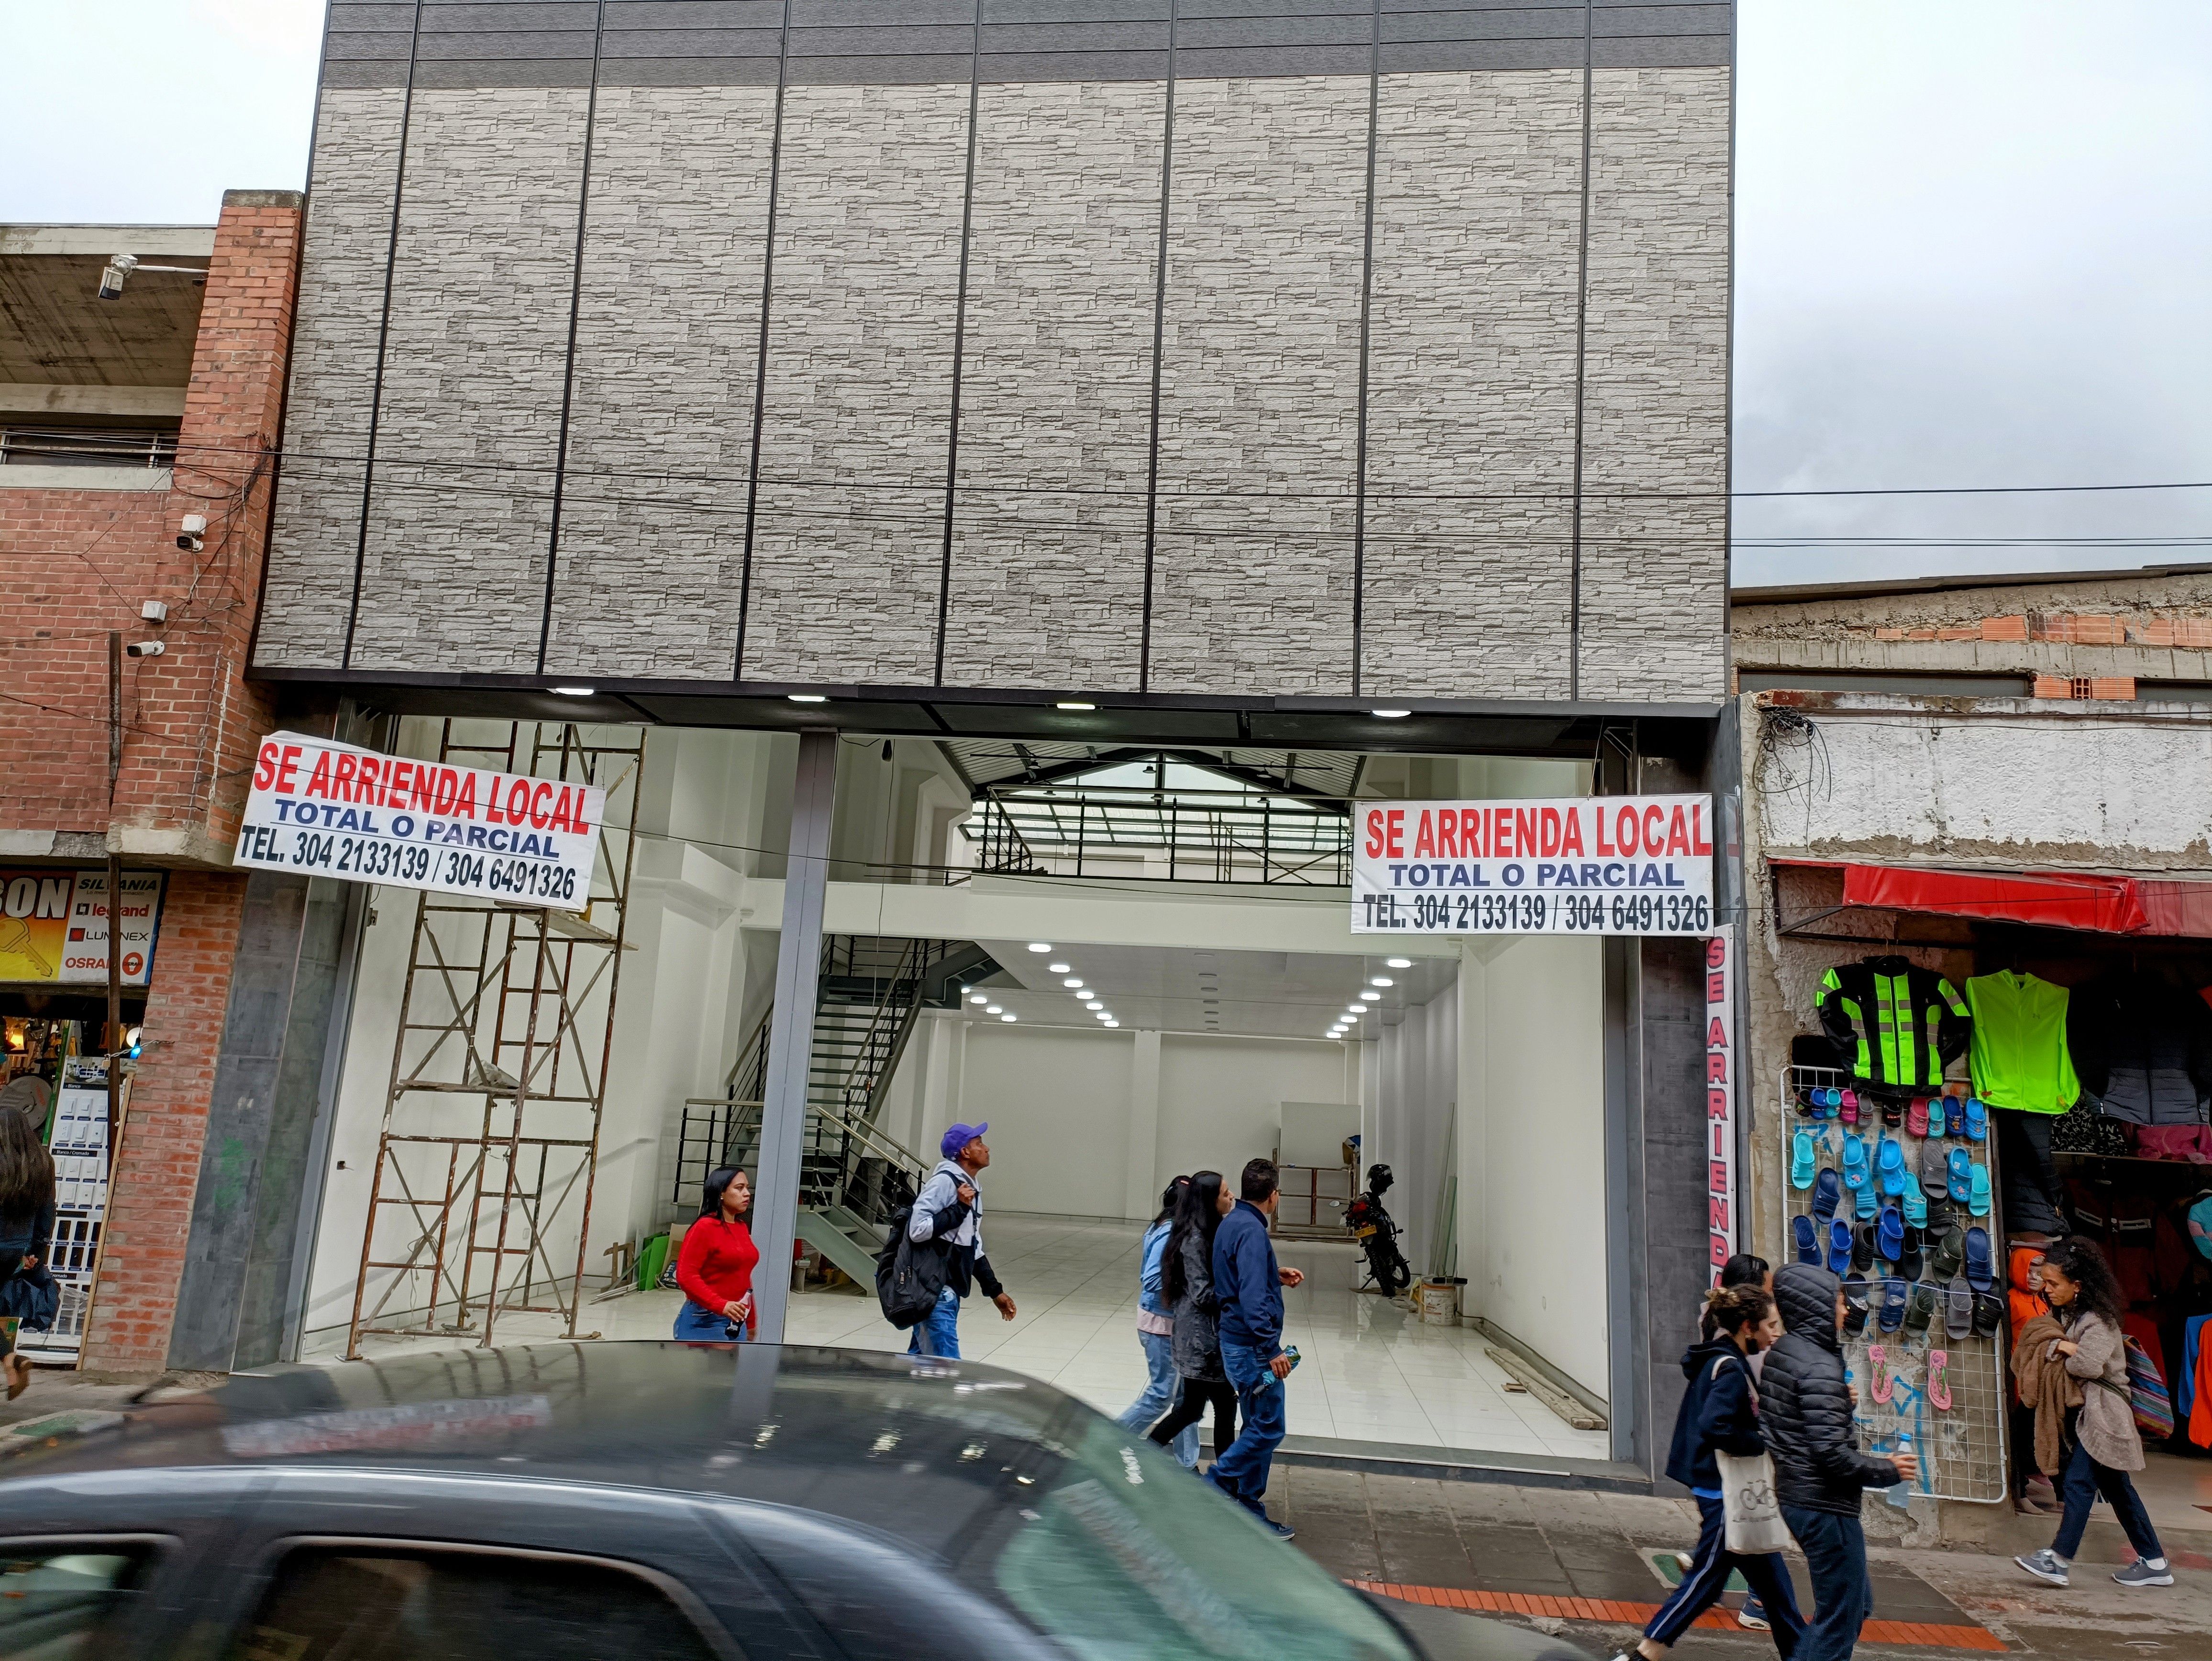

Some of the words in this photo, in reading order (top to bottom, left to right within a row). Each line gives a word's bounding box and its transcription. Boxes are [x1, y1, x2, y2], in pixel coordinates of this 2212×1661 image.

[254, 742, 303, 794] SE
[306, 751, 476, 819] ARRIENDA
[486, 776, 589, 835] LOCAL
[275, 799, 379, 833] TOTAL
[391, 816, 414, 837] O
[425, 820, 559, 858] PARCIAL
[1366, 809, 1405, 859] SE
[1415, 807, 1584, 858] ARRIENDA
[1597, 805, 1712, 857] LOCAL
[241, 825, 285, 863] TEL.
[293, 831, 334, 868] 304
[337, 838, 429, 880] 2133139
[431, 850, 443, 883] /
[445, 852, 483, 887] 304
[489, 858, 576, 900] 6491326
[1389, 864, 1490, 886] TOTAL
[1502, 864, 1525, 886] O
[1538, 863, 1685, 886] PARCIAL
[0, 877, 70, 918] ON
[78, 879, 157, 890] SILANIA
[92, 903, 150, 920] leand
[1363, 894, 1406, 928] TEL.
[1414, 895, 1450, 929] 304
[1457, 895, 1546, 930] 2133139
[1552, 895, 1559, 930] /
[1565, 895, 1604, 930] 304
[1612, 895, 1709, 931] 6491326
[86, 931, 148, 941] LUNEX
[65, 957, 110, 969] OSRA
[1706, 935, 1725, 1004] SE
